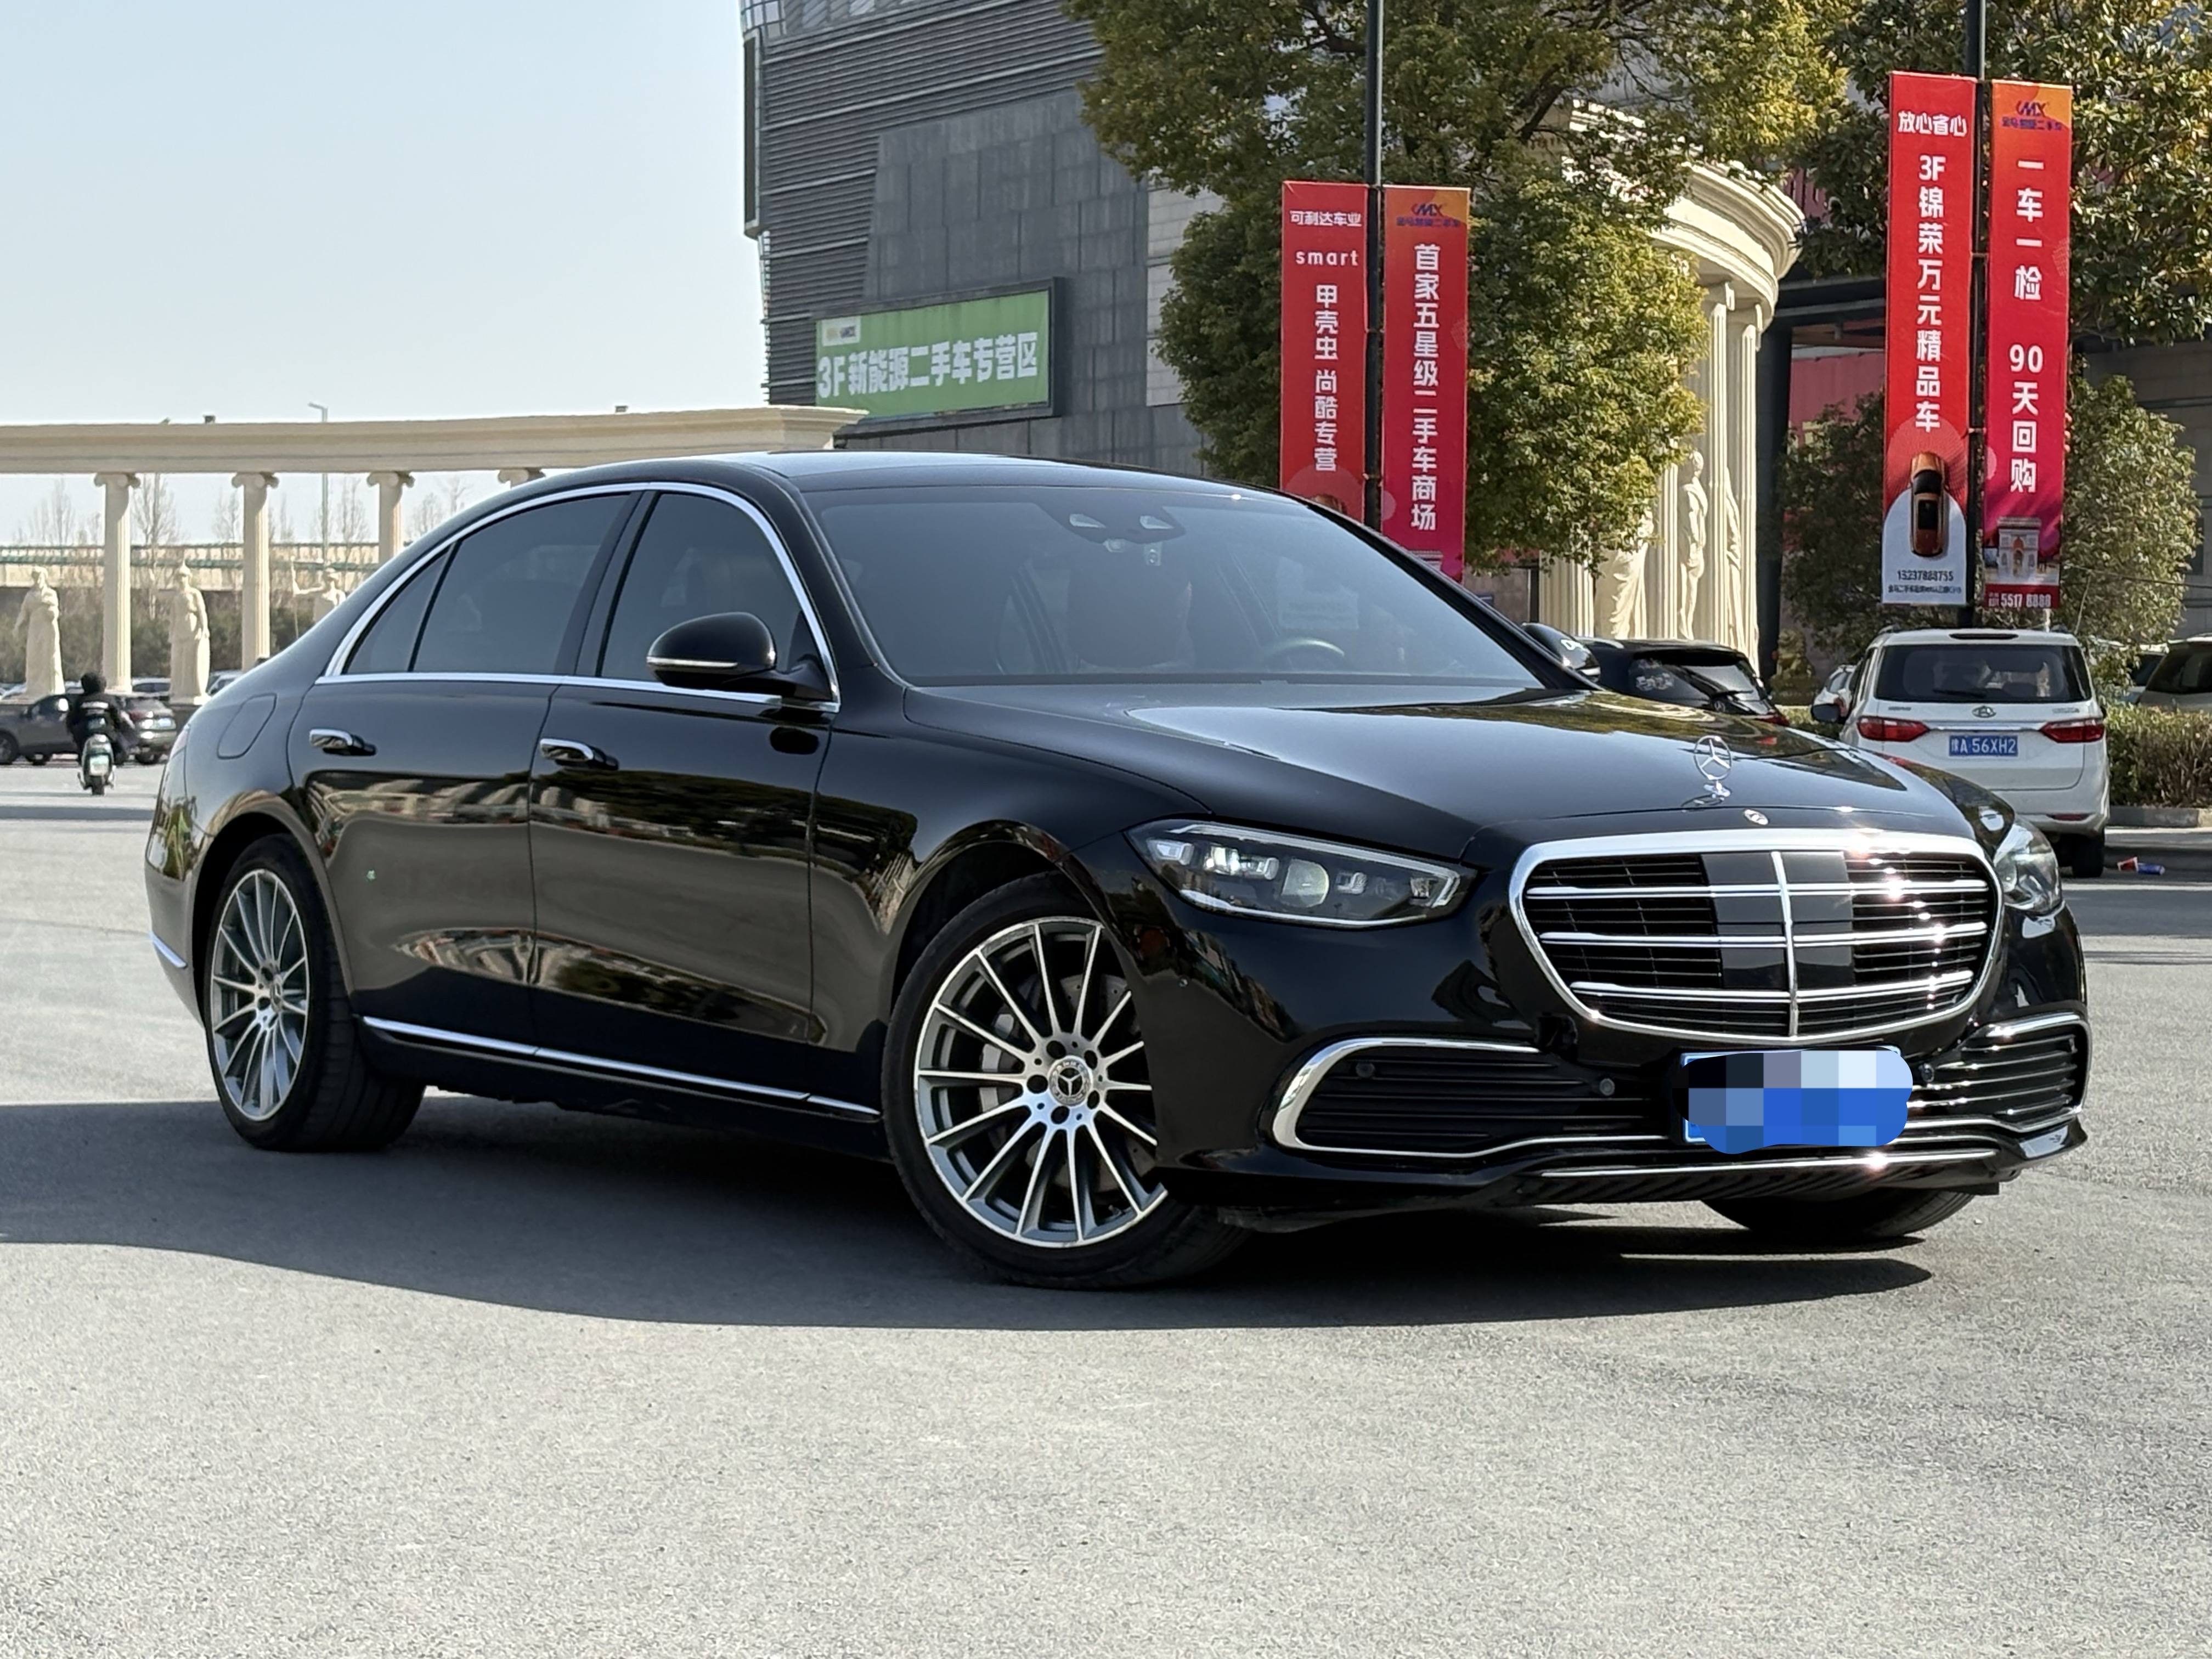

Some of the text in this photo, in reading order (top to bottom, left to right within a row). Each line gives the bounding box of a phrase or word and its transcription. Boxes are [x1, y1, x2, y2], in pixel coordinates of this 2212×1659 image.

[1898, 111, 1967, 137] 放心省心
[1289, 210, 1362, 227] 可利达车业
[1295, 250, 1359, 267] smart
[1410, 244, 1441, 531] 首家五星级二手车商场
